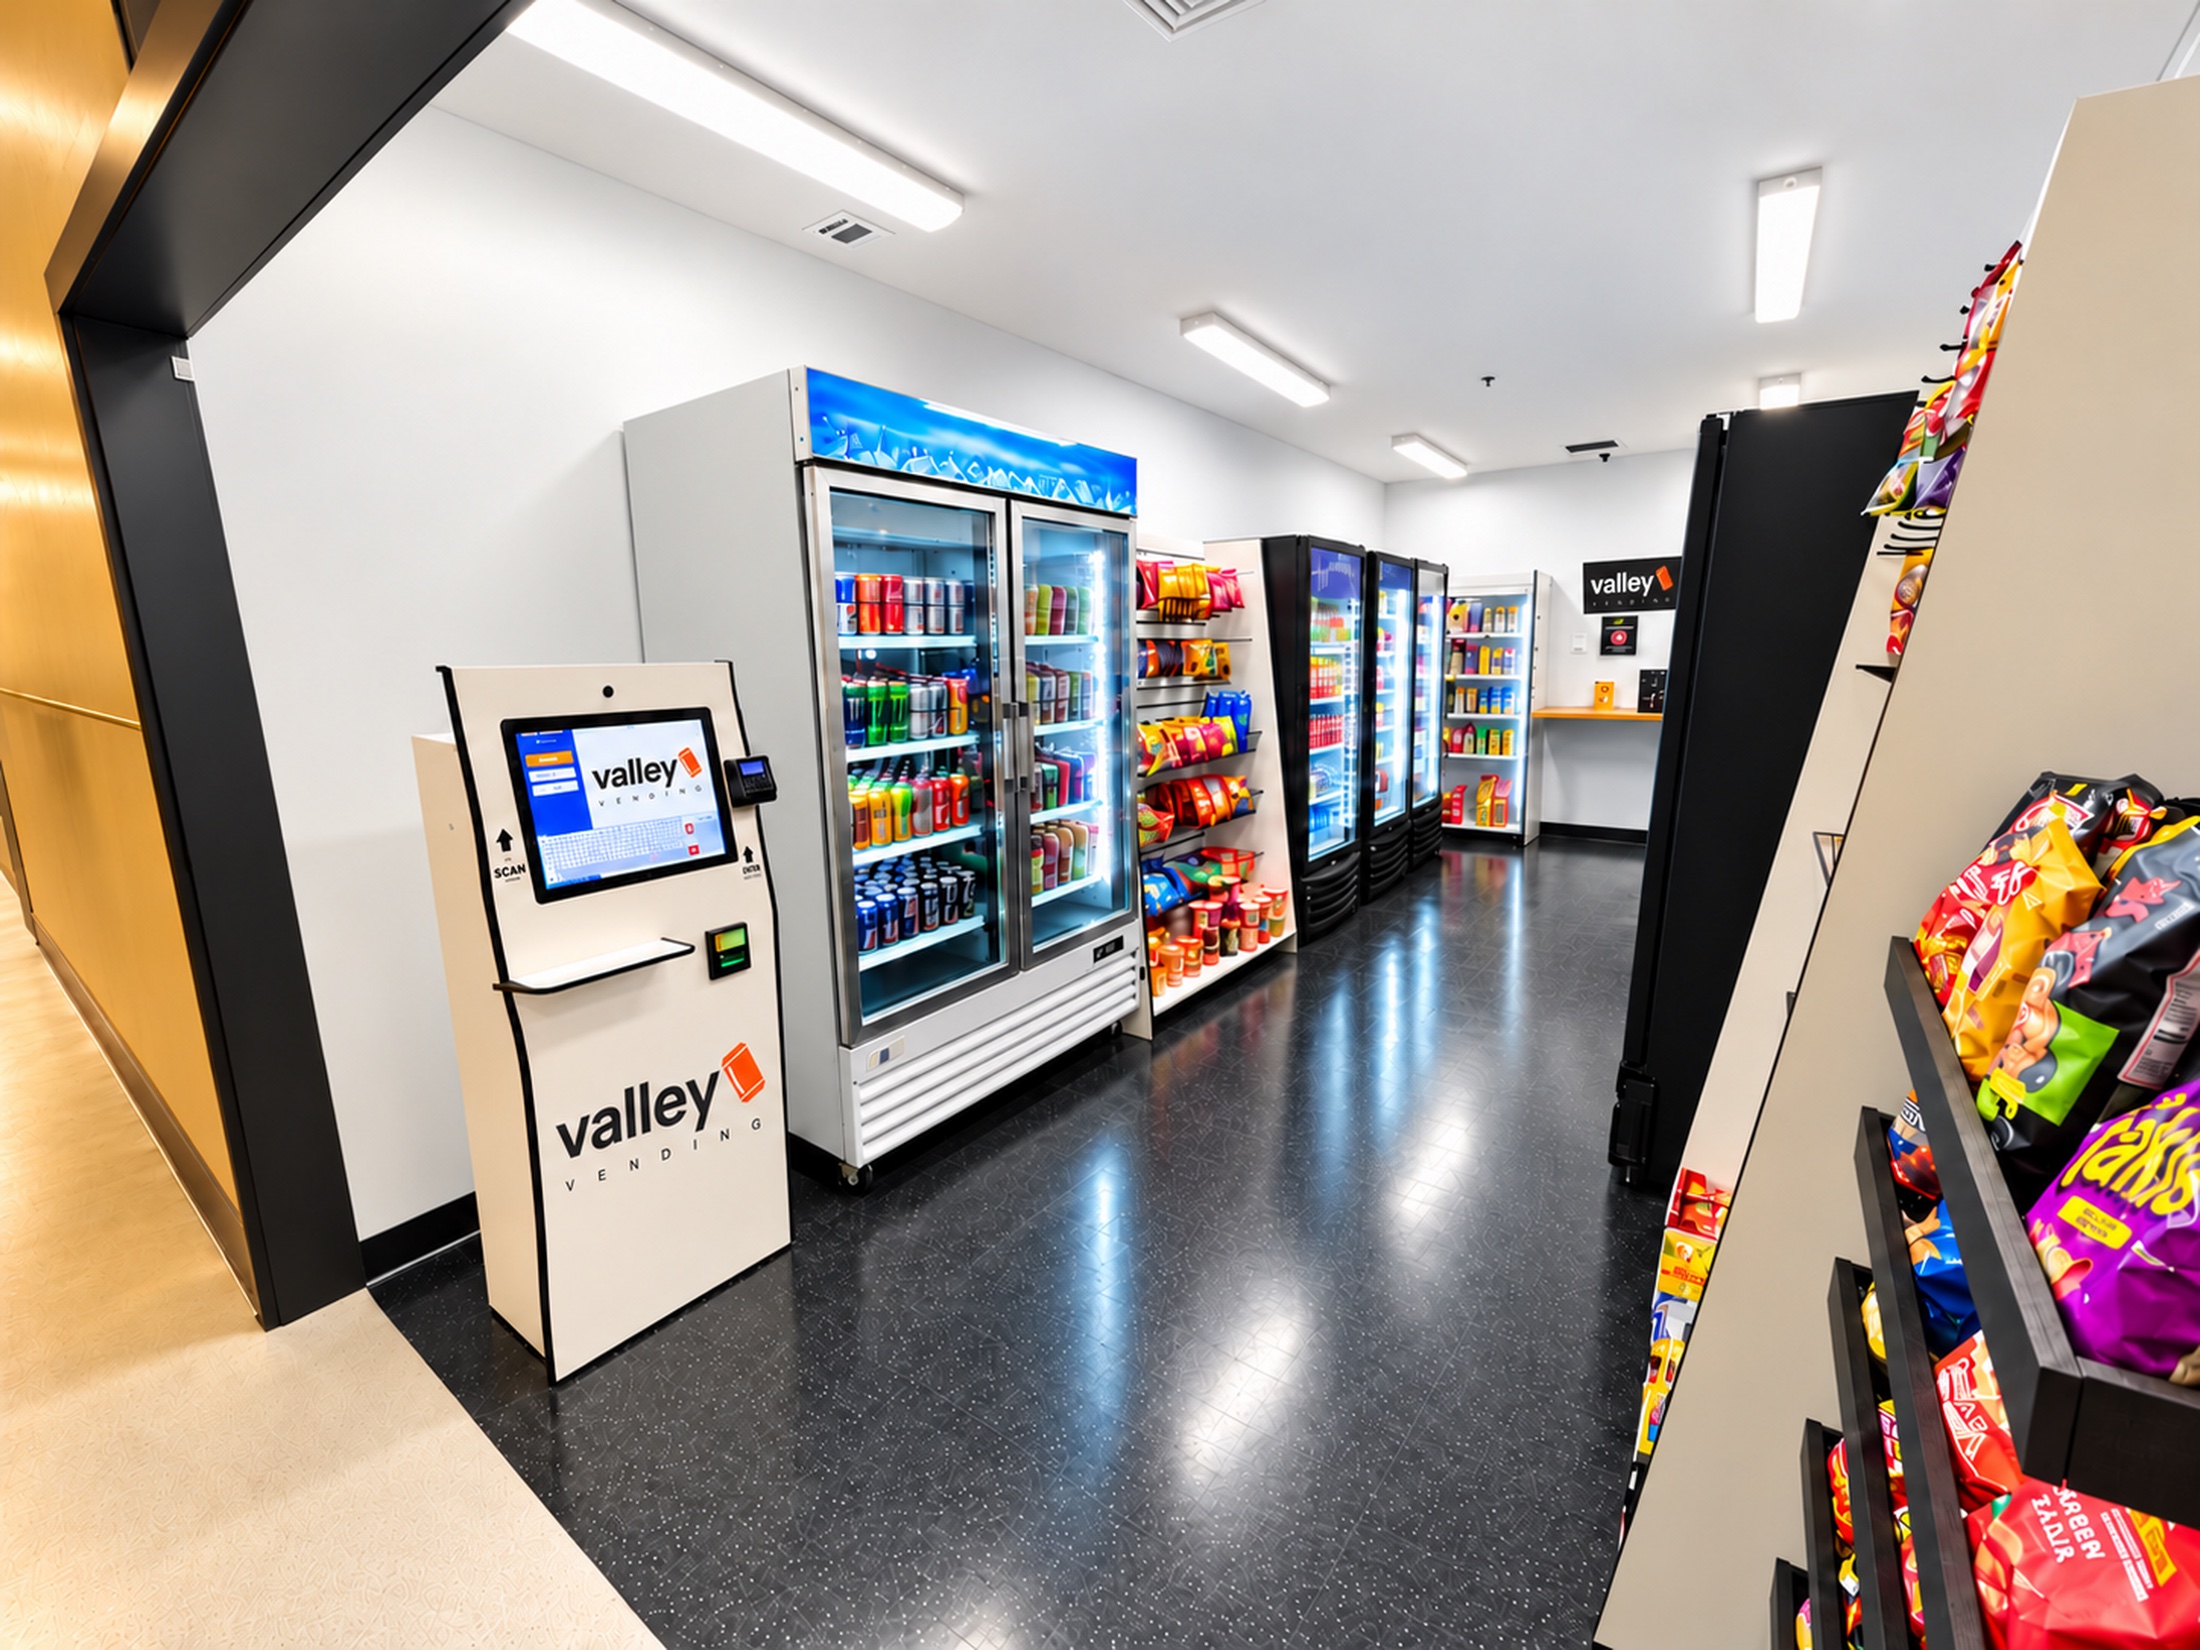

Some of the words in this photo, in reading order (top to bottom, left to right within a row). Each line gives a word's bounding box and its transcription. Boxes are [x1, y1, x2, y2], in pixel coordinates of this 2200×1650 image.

[1590, 571, 1655, 597] valley
[591, 757, 679, 790] valley
[598, 784, 702, 807] VENDING
[493, 863, 526, 879] SCAN
[555, 1069, 721, 1159] valley
[565, 1117, 762, 1192] VENDING
